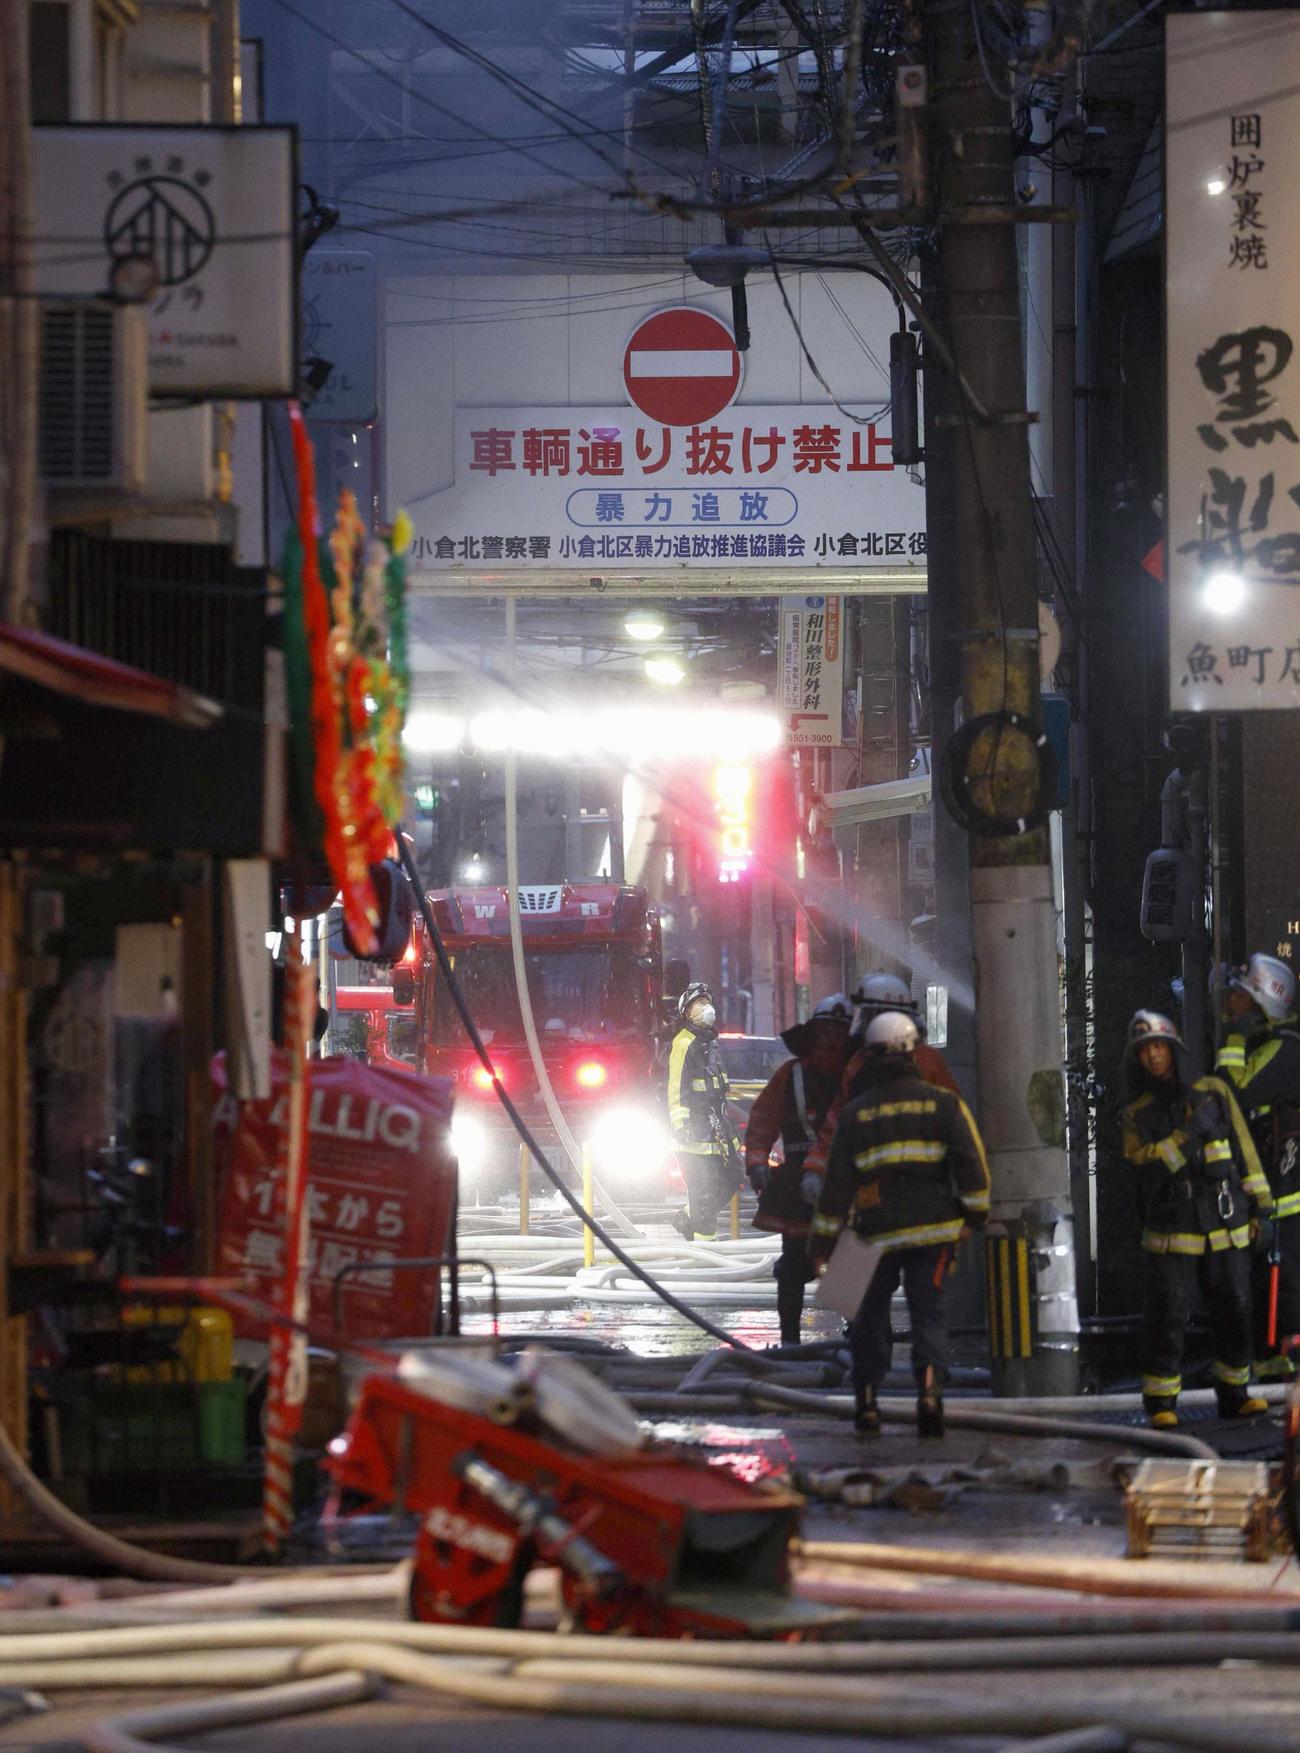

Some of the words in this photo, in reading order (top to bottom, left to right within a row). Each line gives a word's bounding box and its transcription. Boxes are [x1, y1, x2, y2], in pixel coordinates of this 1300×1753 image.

[1227, 113, 1268, 270] 囲炉裏焼
[468, 423, 895, 477] 車輌通り抜け禁止
[594, 492, 769, 522] 暴力追放
[411, 535, 551, 560] 小倉北警察署
[558, 534, 806, 559] 小倉北区暴力追放推進協議会
